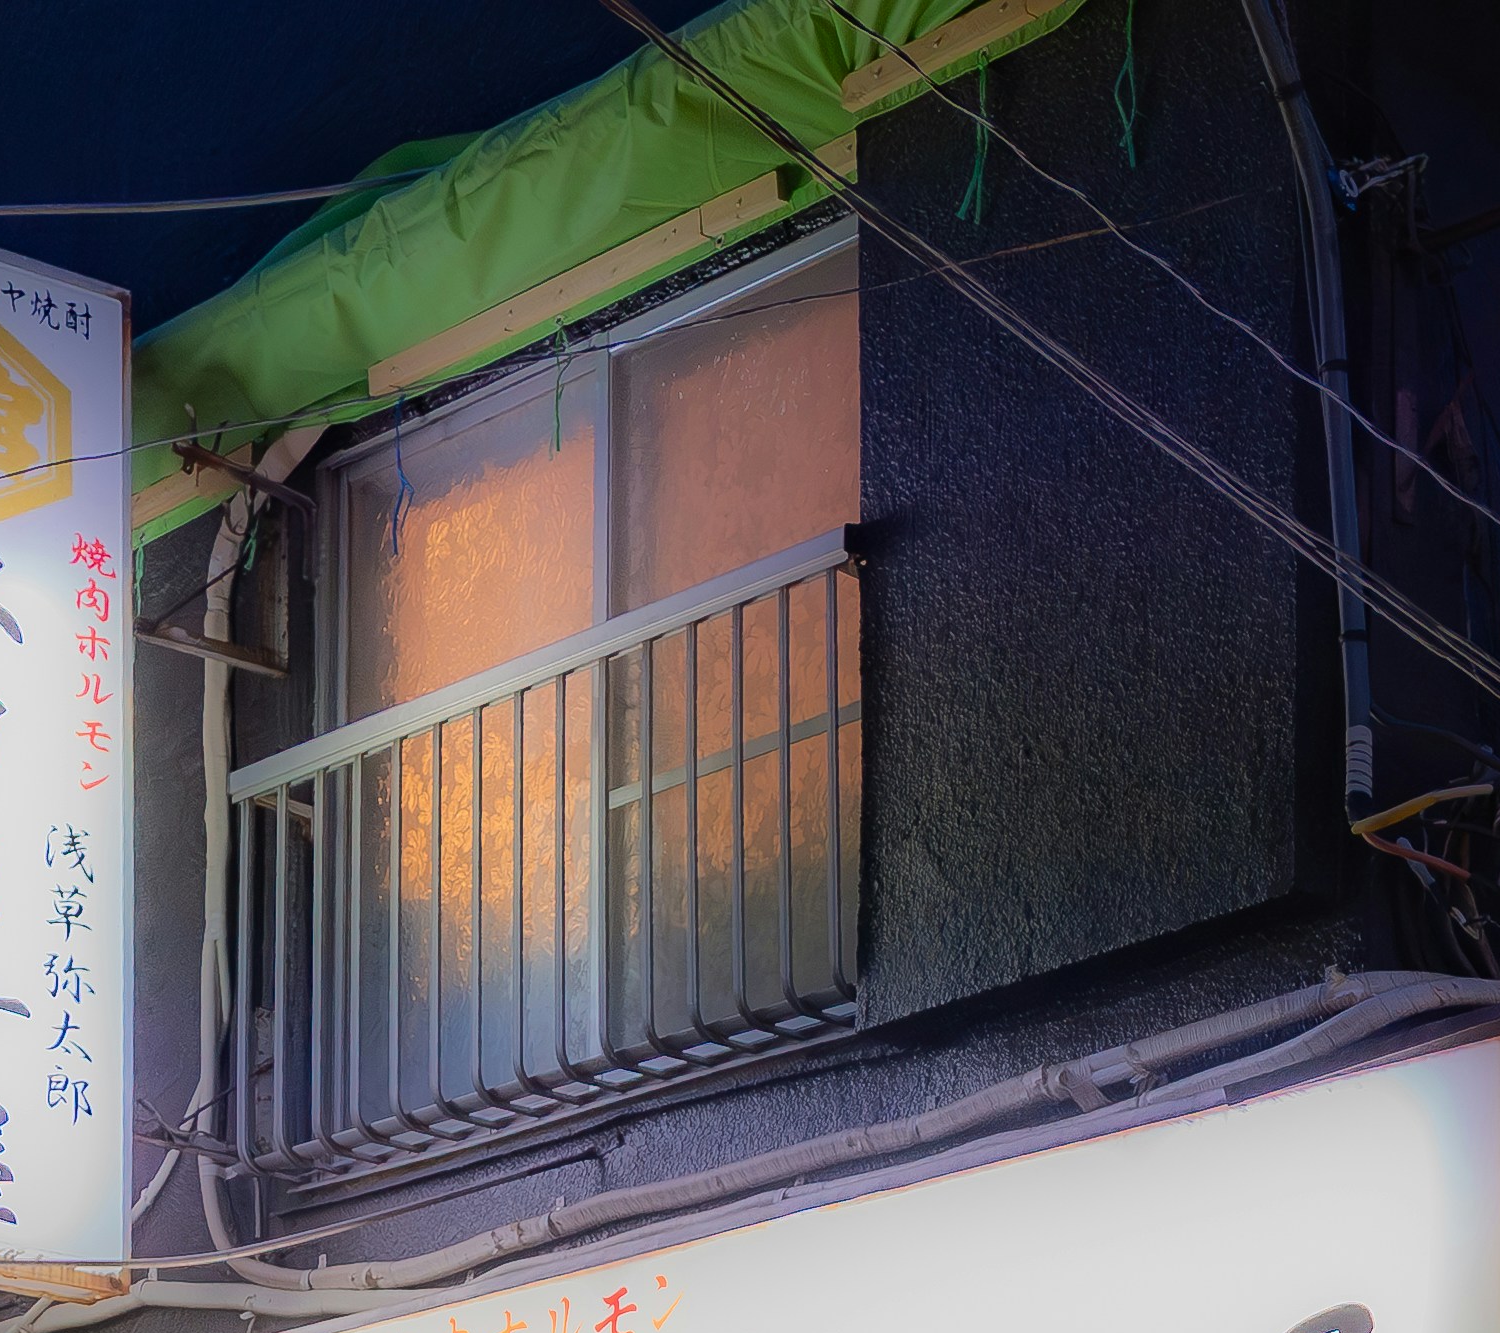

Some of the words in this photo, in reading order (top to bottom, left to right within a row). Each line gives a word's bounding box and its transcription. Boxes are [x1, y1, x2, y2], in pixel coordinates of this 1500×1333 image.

[69, 531, 117, 791] 焼肉ホルモン
[43, 822, 97, 1127] 浅草弥太郎
